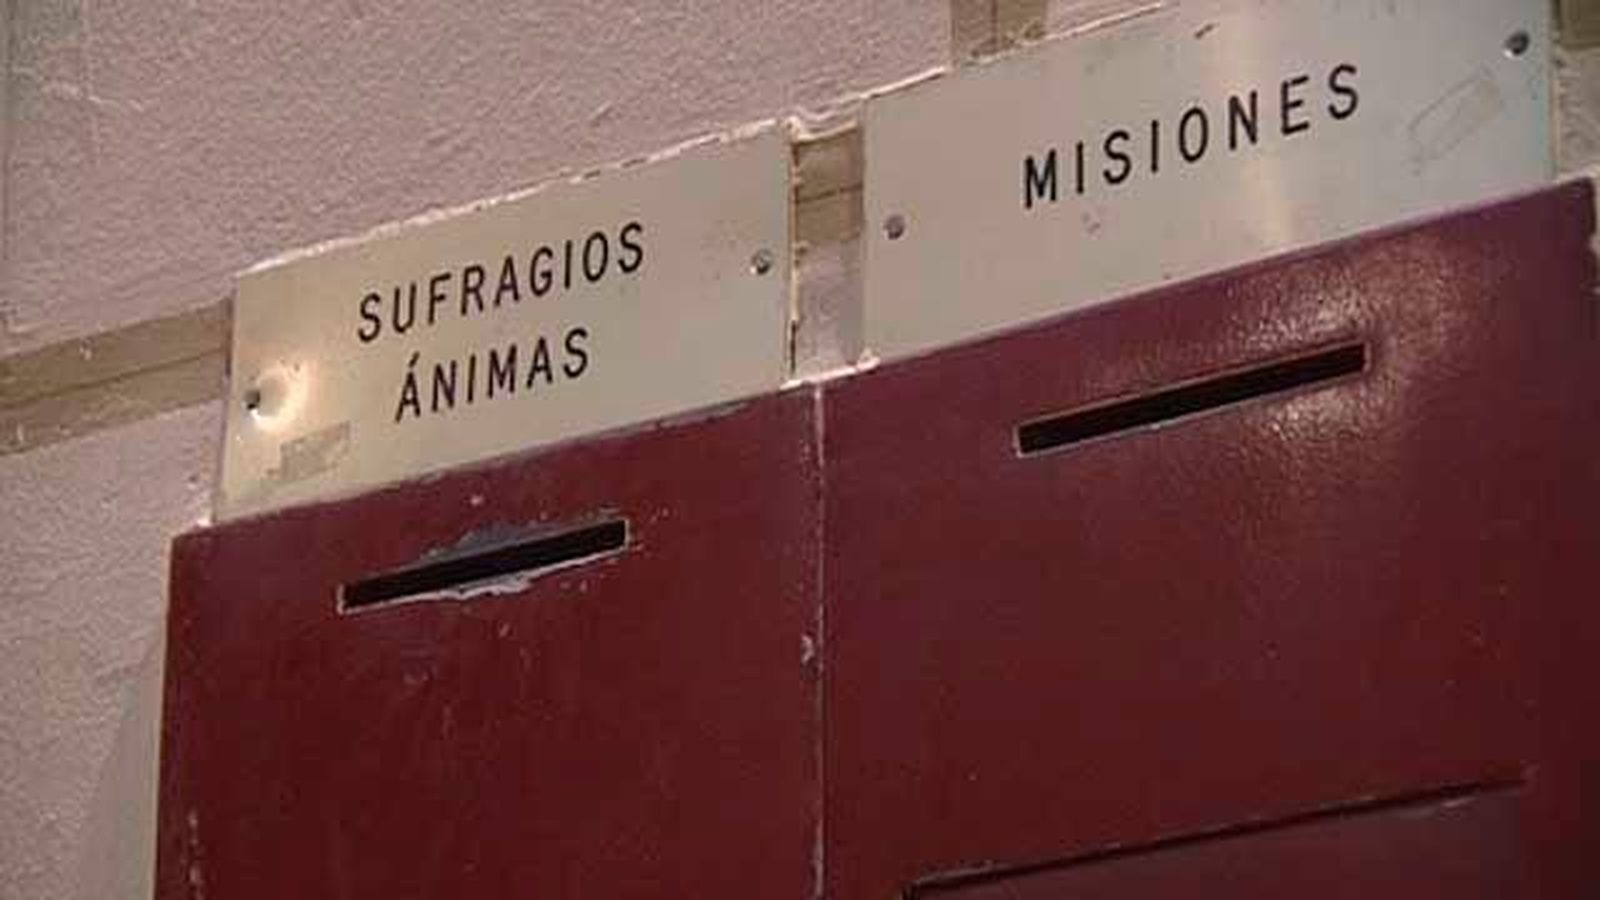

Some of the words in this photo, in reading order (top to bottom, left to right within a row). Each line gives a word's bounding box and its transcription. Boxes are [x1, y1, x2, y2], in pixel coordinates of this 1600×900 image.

[1023, 63, 1361, 210] MISIONES
[357, 220, 647, 343] SUFRAGIOS
[395, 326, 591, 423] ÁNIMAS
